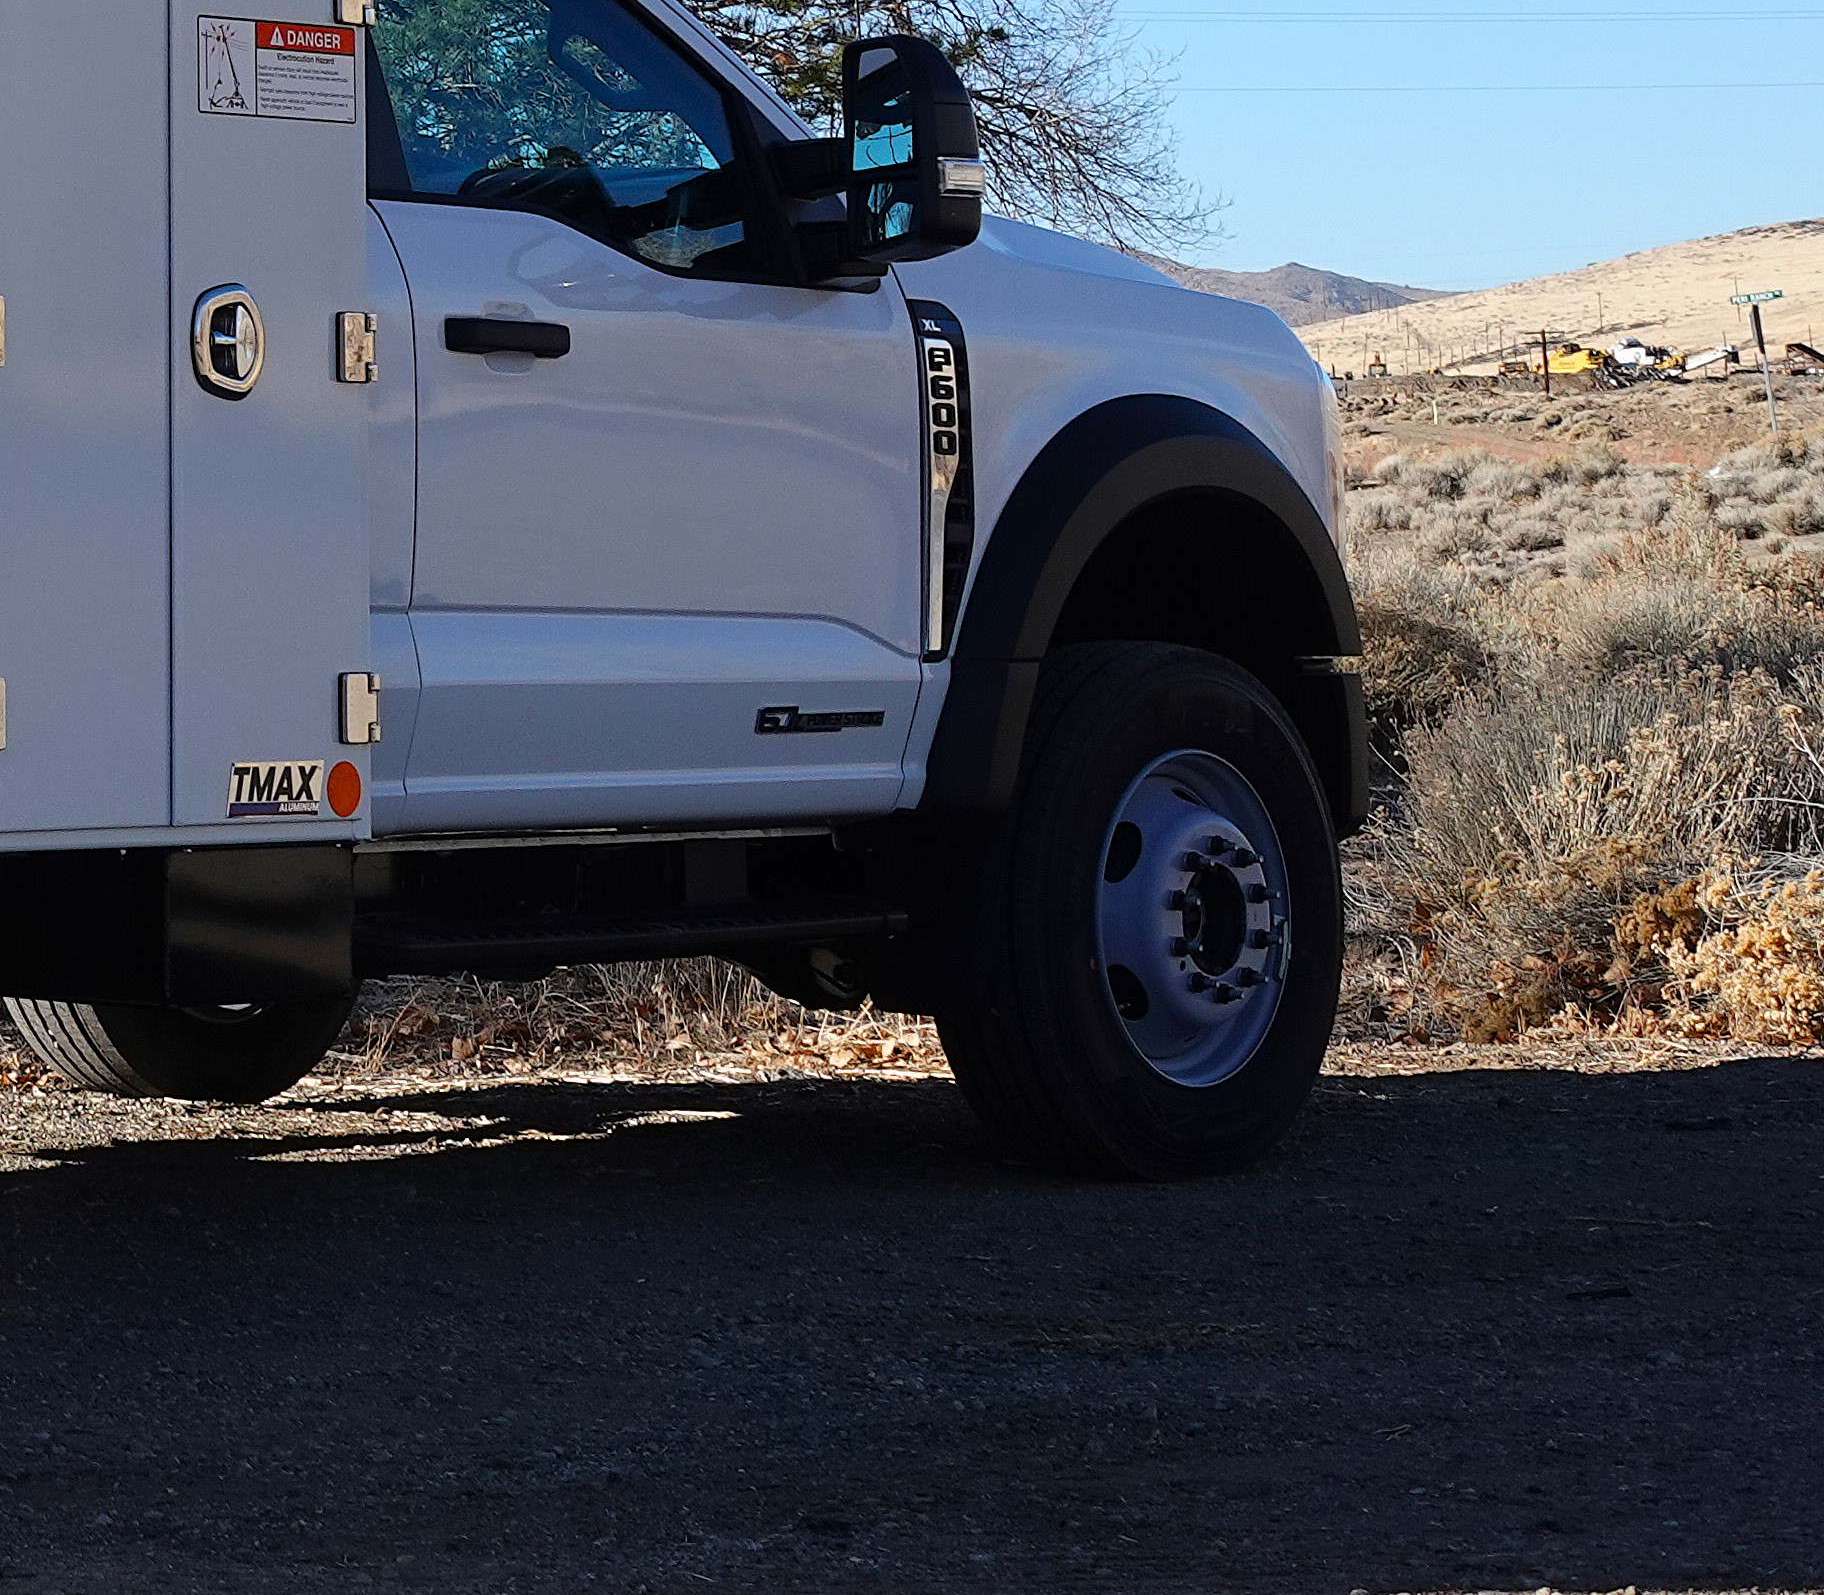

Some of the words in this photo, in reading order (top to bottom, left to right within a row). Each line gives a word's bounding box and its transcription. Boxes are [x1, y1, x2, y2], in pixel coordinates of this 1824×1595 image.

[287, 29, 341, 49] DANGER
[921, 318, 942, 333] XL
[233, 765, 318, 802] TMAX
